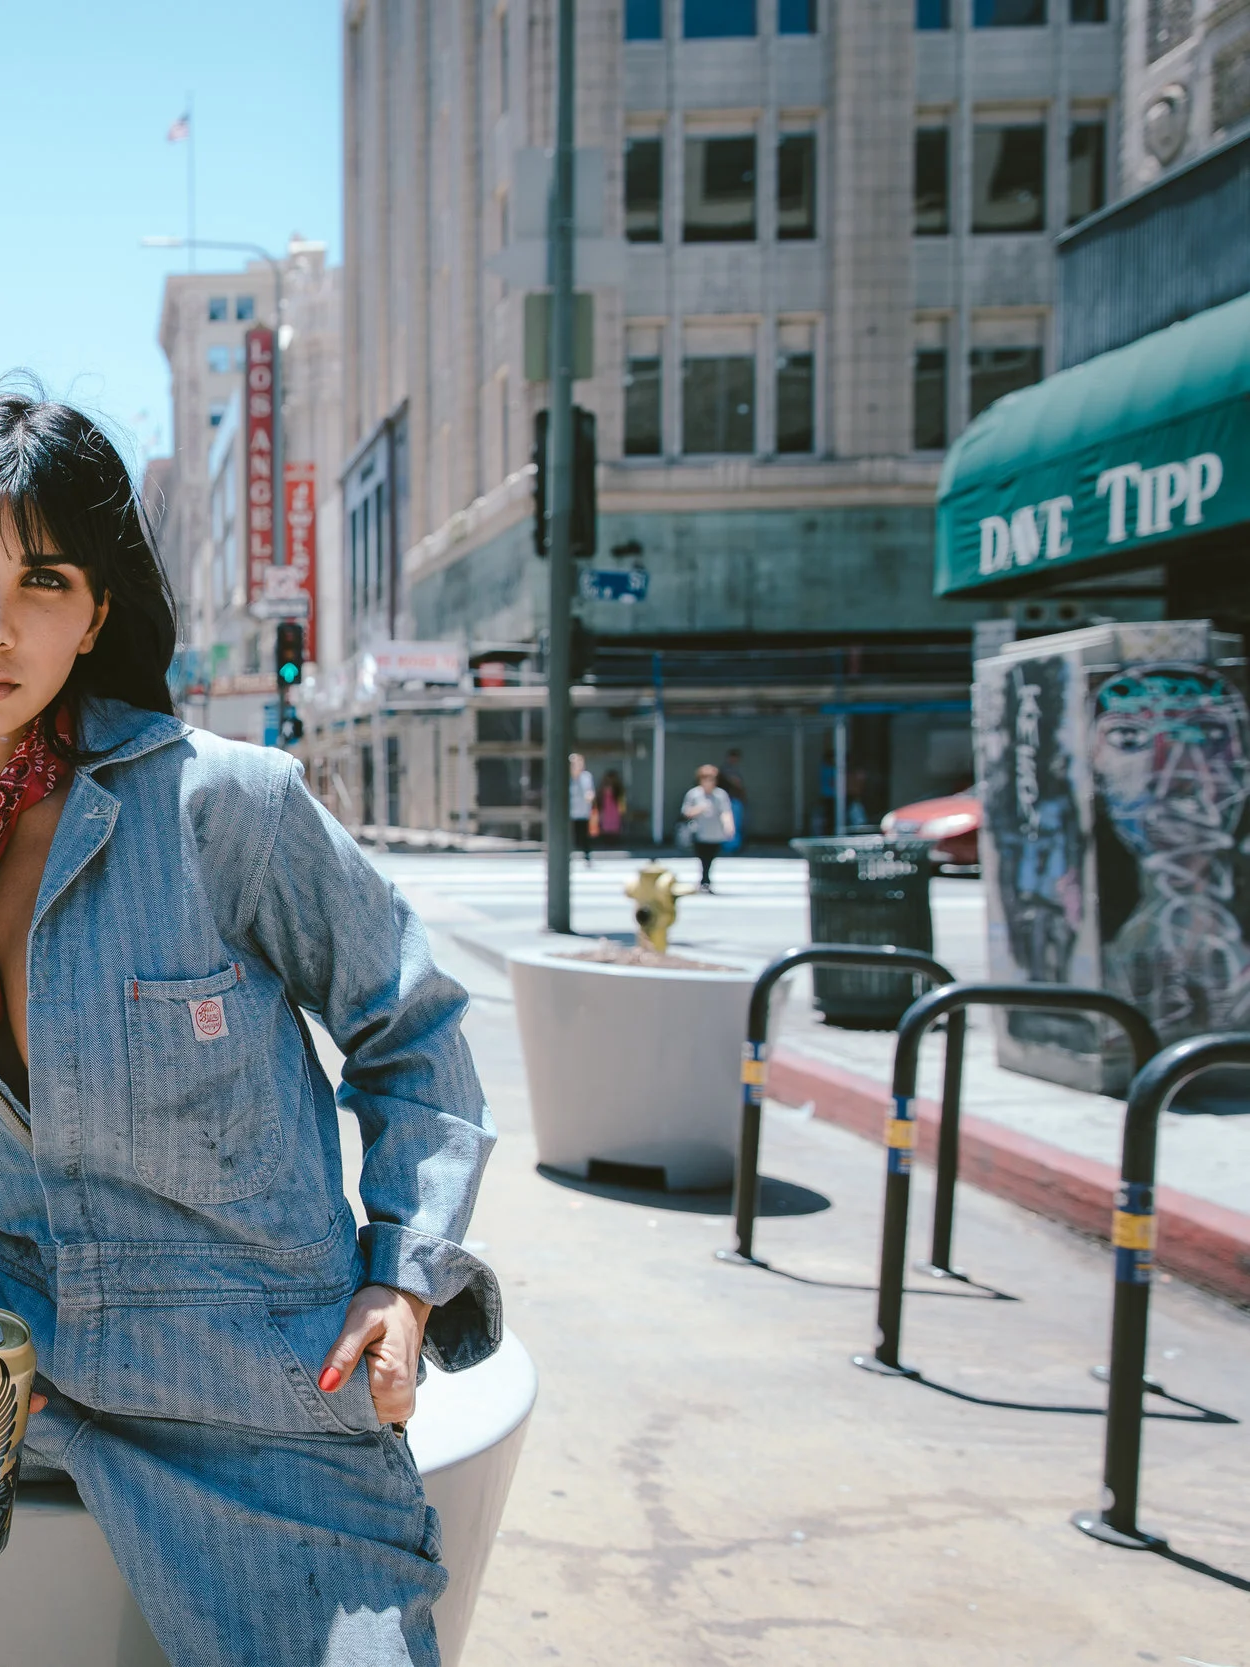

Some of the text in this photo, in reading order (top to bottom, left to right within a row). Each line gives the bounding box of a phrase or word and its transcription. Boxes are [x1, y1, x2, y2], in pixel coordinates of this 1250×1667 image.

[249, 338, 271, 419] LOS
[977, 452, 1224, 577] DAVE TIPP
